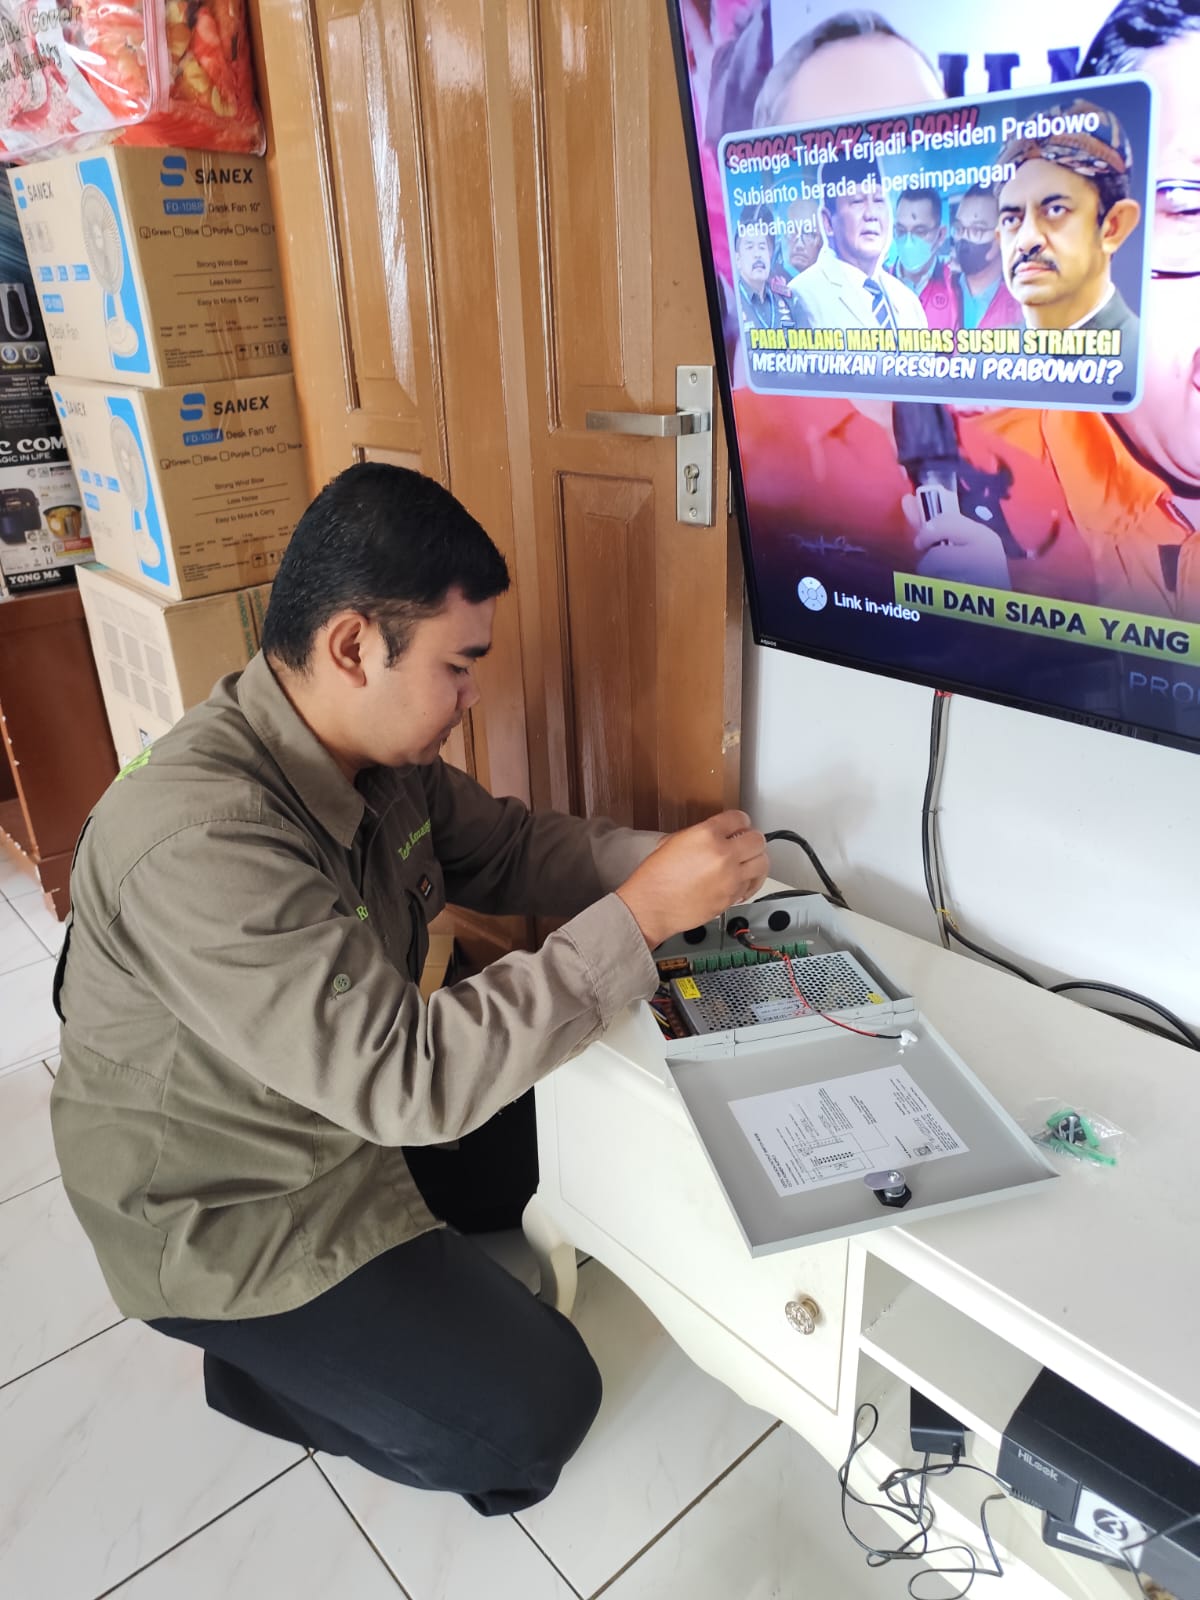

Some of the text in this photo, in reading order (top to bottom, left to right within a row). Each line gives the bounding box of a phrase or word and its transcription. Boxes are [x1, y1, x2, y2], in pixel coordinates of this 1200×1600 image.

[27, 6, 82, 36] Cover
[729, 111, 1100, 175] Semoga Tidak Terjadi! Presiden Prabowo
[195, 168, 253, 184] SANEX
[733, 161, 1016, 208] Subianto berada di persimpangan
[27, 181, 54, 203] SANEX
[231, 202, 248, 213] Fan
[736, 214, 818, 240] berbahaya!
[750, 328, 1122, 357] PARA DALANG MAFIA MIGAS SUSUN STRATEGI
[751, 351, 1124, 385] MERUNTUHKAN PRESIDEN PRABOWO!?
[213, 395, 270, 416] SANEX
[225, 430, 246, 441] Desk
[248, 427, 264, 437] Fan
[31, 451, 51, 461] LIFE
[8, 571, 41, 585] YONG
[42, 569, 61, 580] MA
[833, 591, 921, 622] Link in-video
[904, 582, 1191, 655] INI DAN SIAPA YANG
